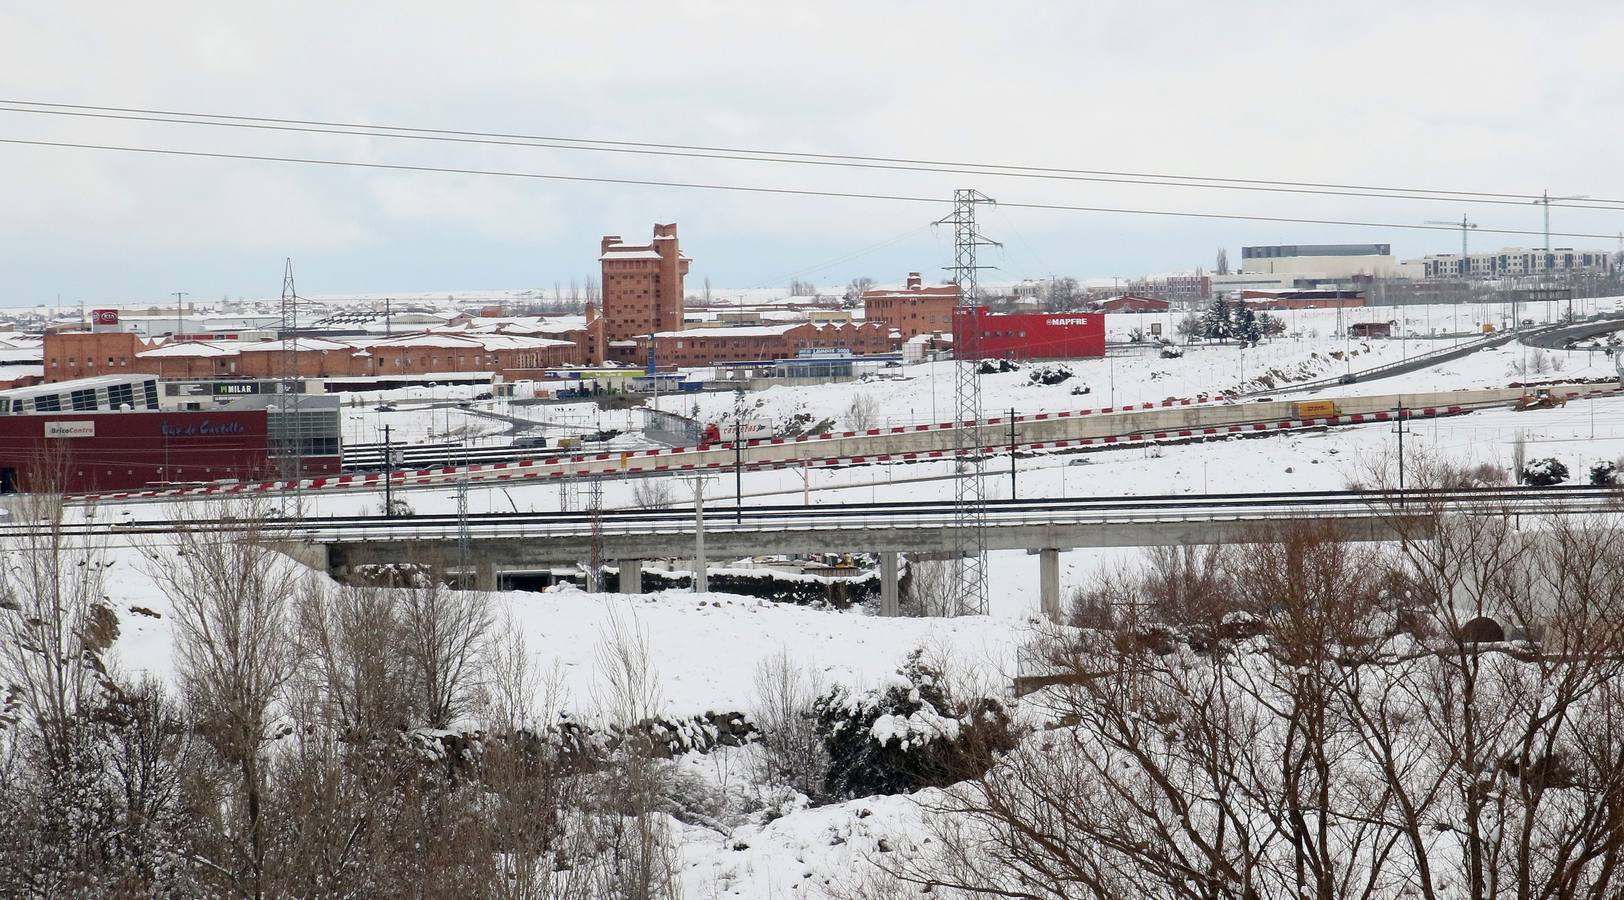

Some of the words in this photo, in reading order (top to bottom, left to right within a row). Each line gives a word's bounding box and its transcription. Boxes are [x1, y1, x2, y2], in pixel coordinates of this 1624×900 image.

[1052, 318, 1088, 326] MAPFRE
[228, 385, 252, 393] MILAR
[724, 426, 757, 434] careras
